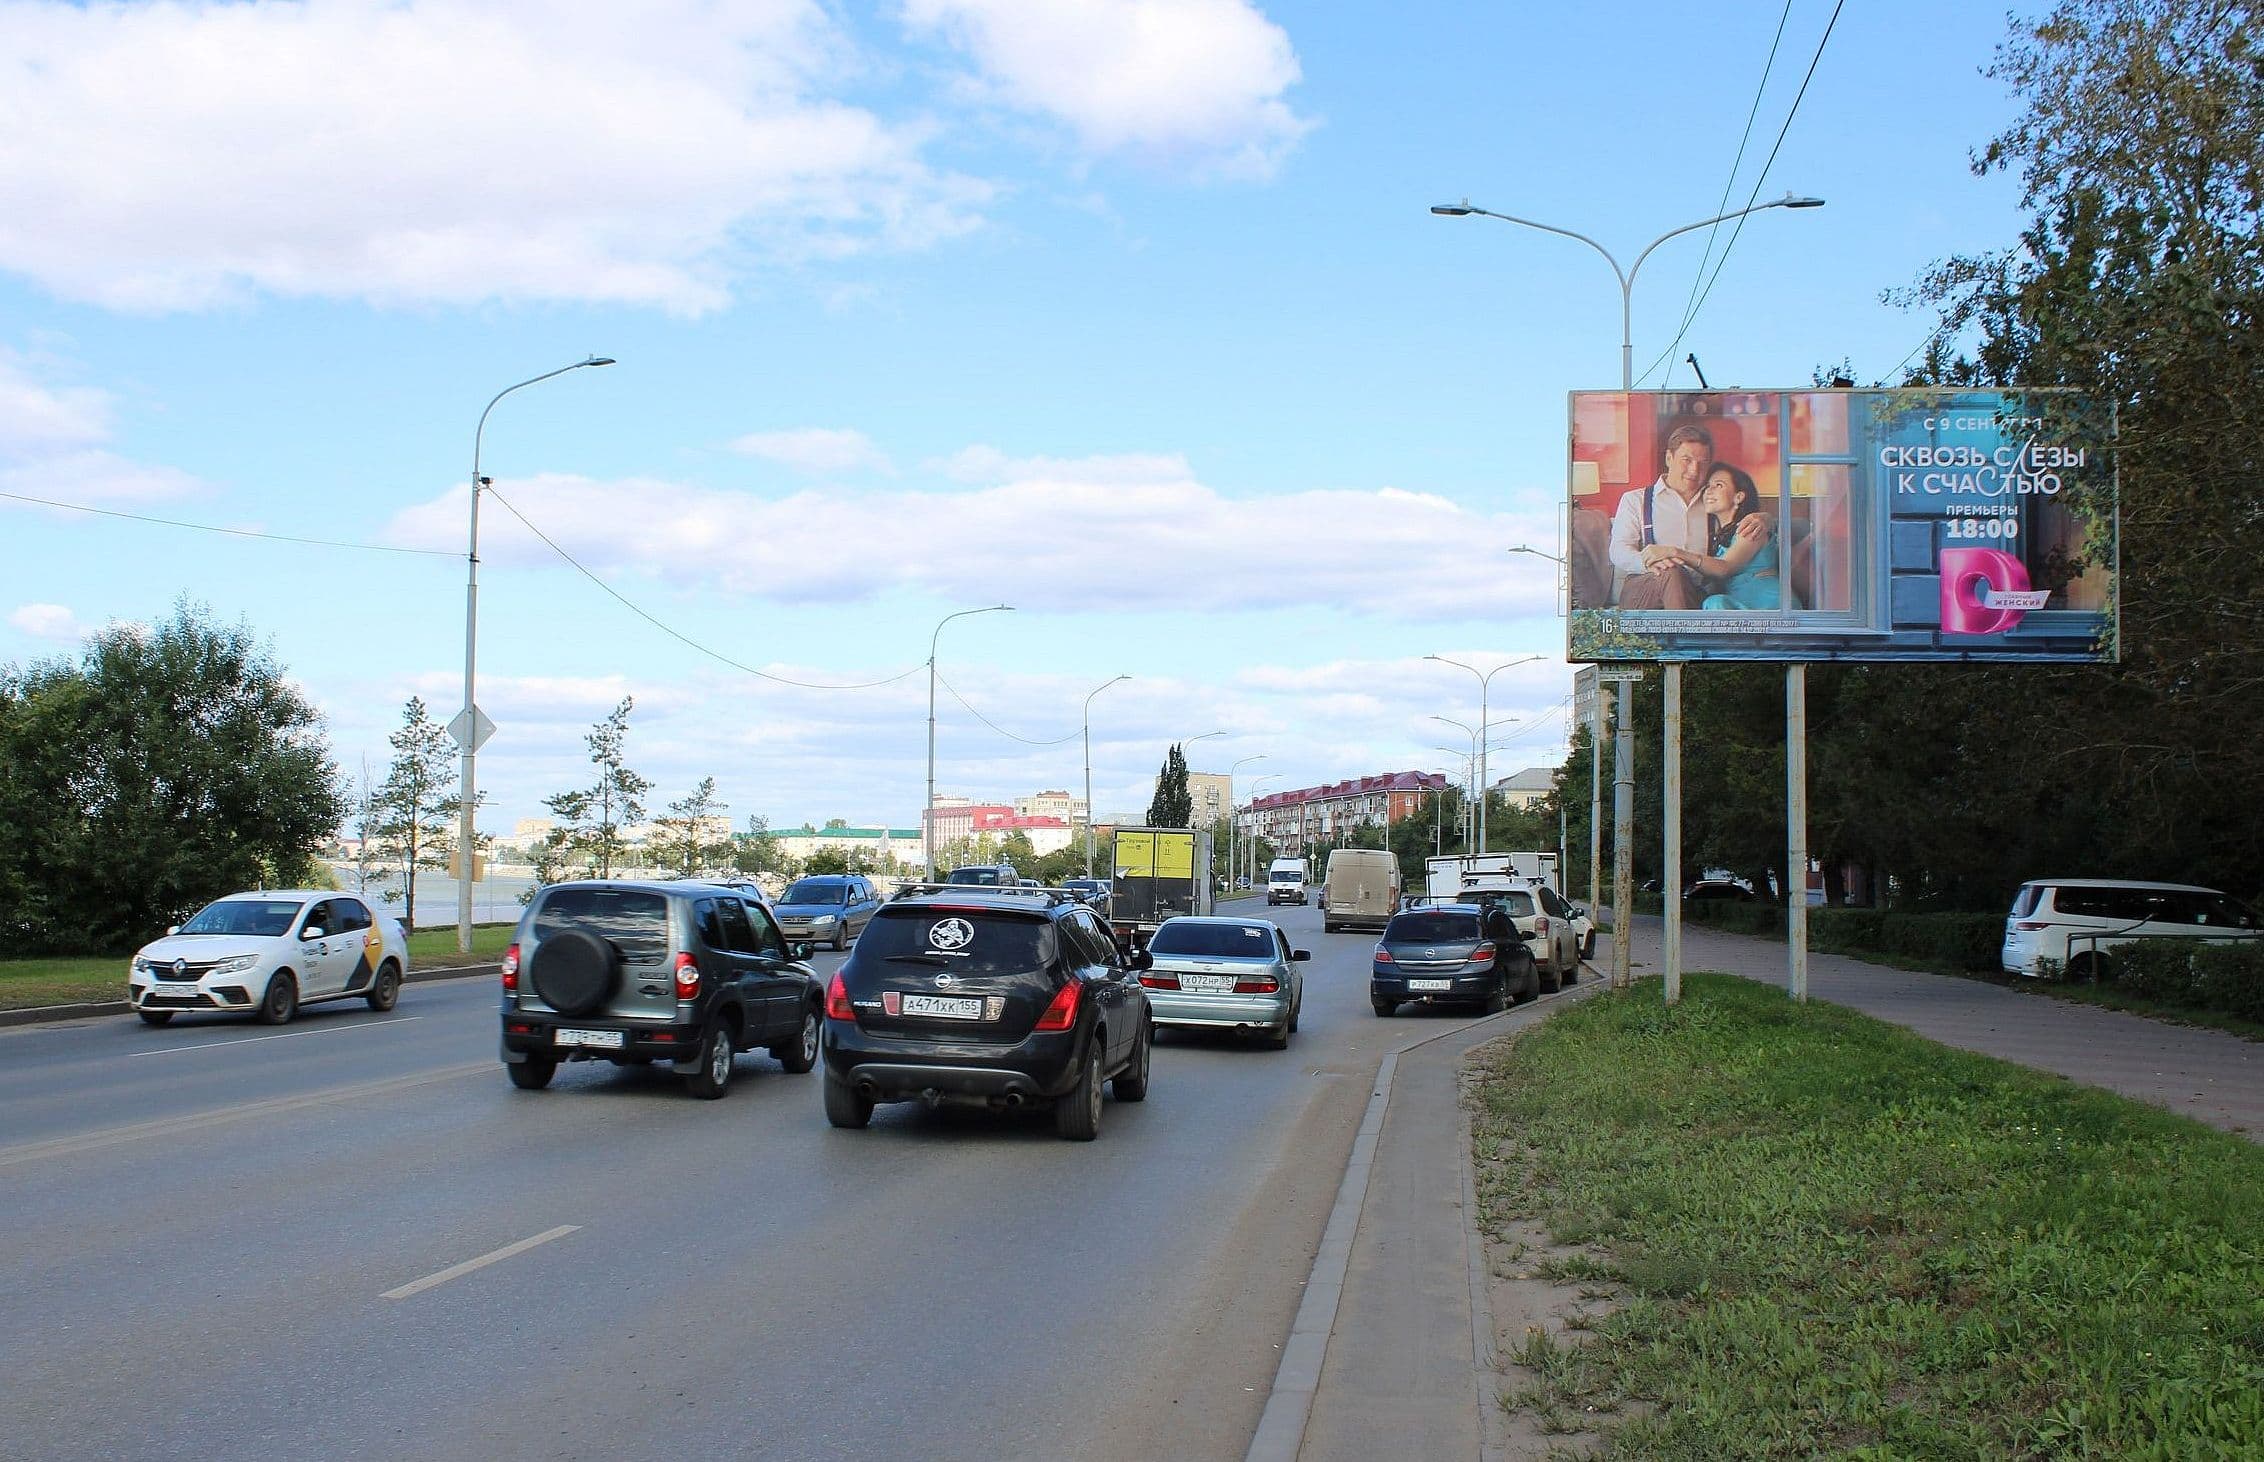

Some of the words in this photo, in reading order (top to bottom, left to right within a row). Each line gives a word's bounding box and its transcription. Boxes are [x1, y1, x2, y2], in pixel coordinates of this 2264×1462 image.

[1923, 418, 1935, 431] С
[1940, 418, 1949, 431] 9
[1880, 446, 1986, 467] СКВОЗЬ
[1898, 473, 1916, 494] К
[1923, 466, 2062, 497] СЧАСТЬЮ
[1946, 505, 2018, 516] ПРЕМЬЕРЫ
[1947, 518, 2018, 539] 18:00
[1600, 618, 1619, 634] 16+
